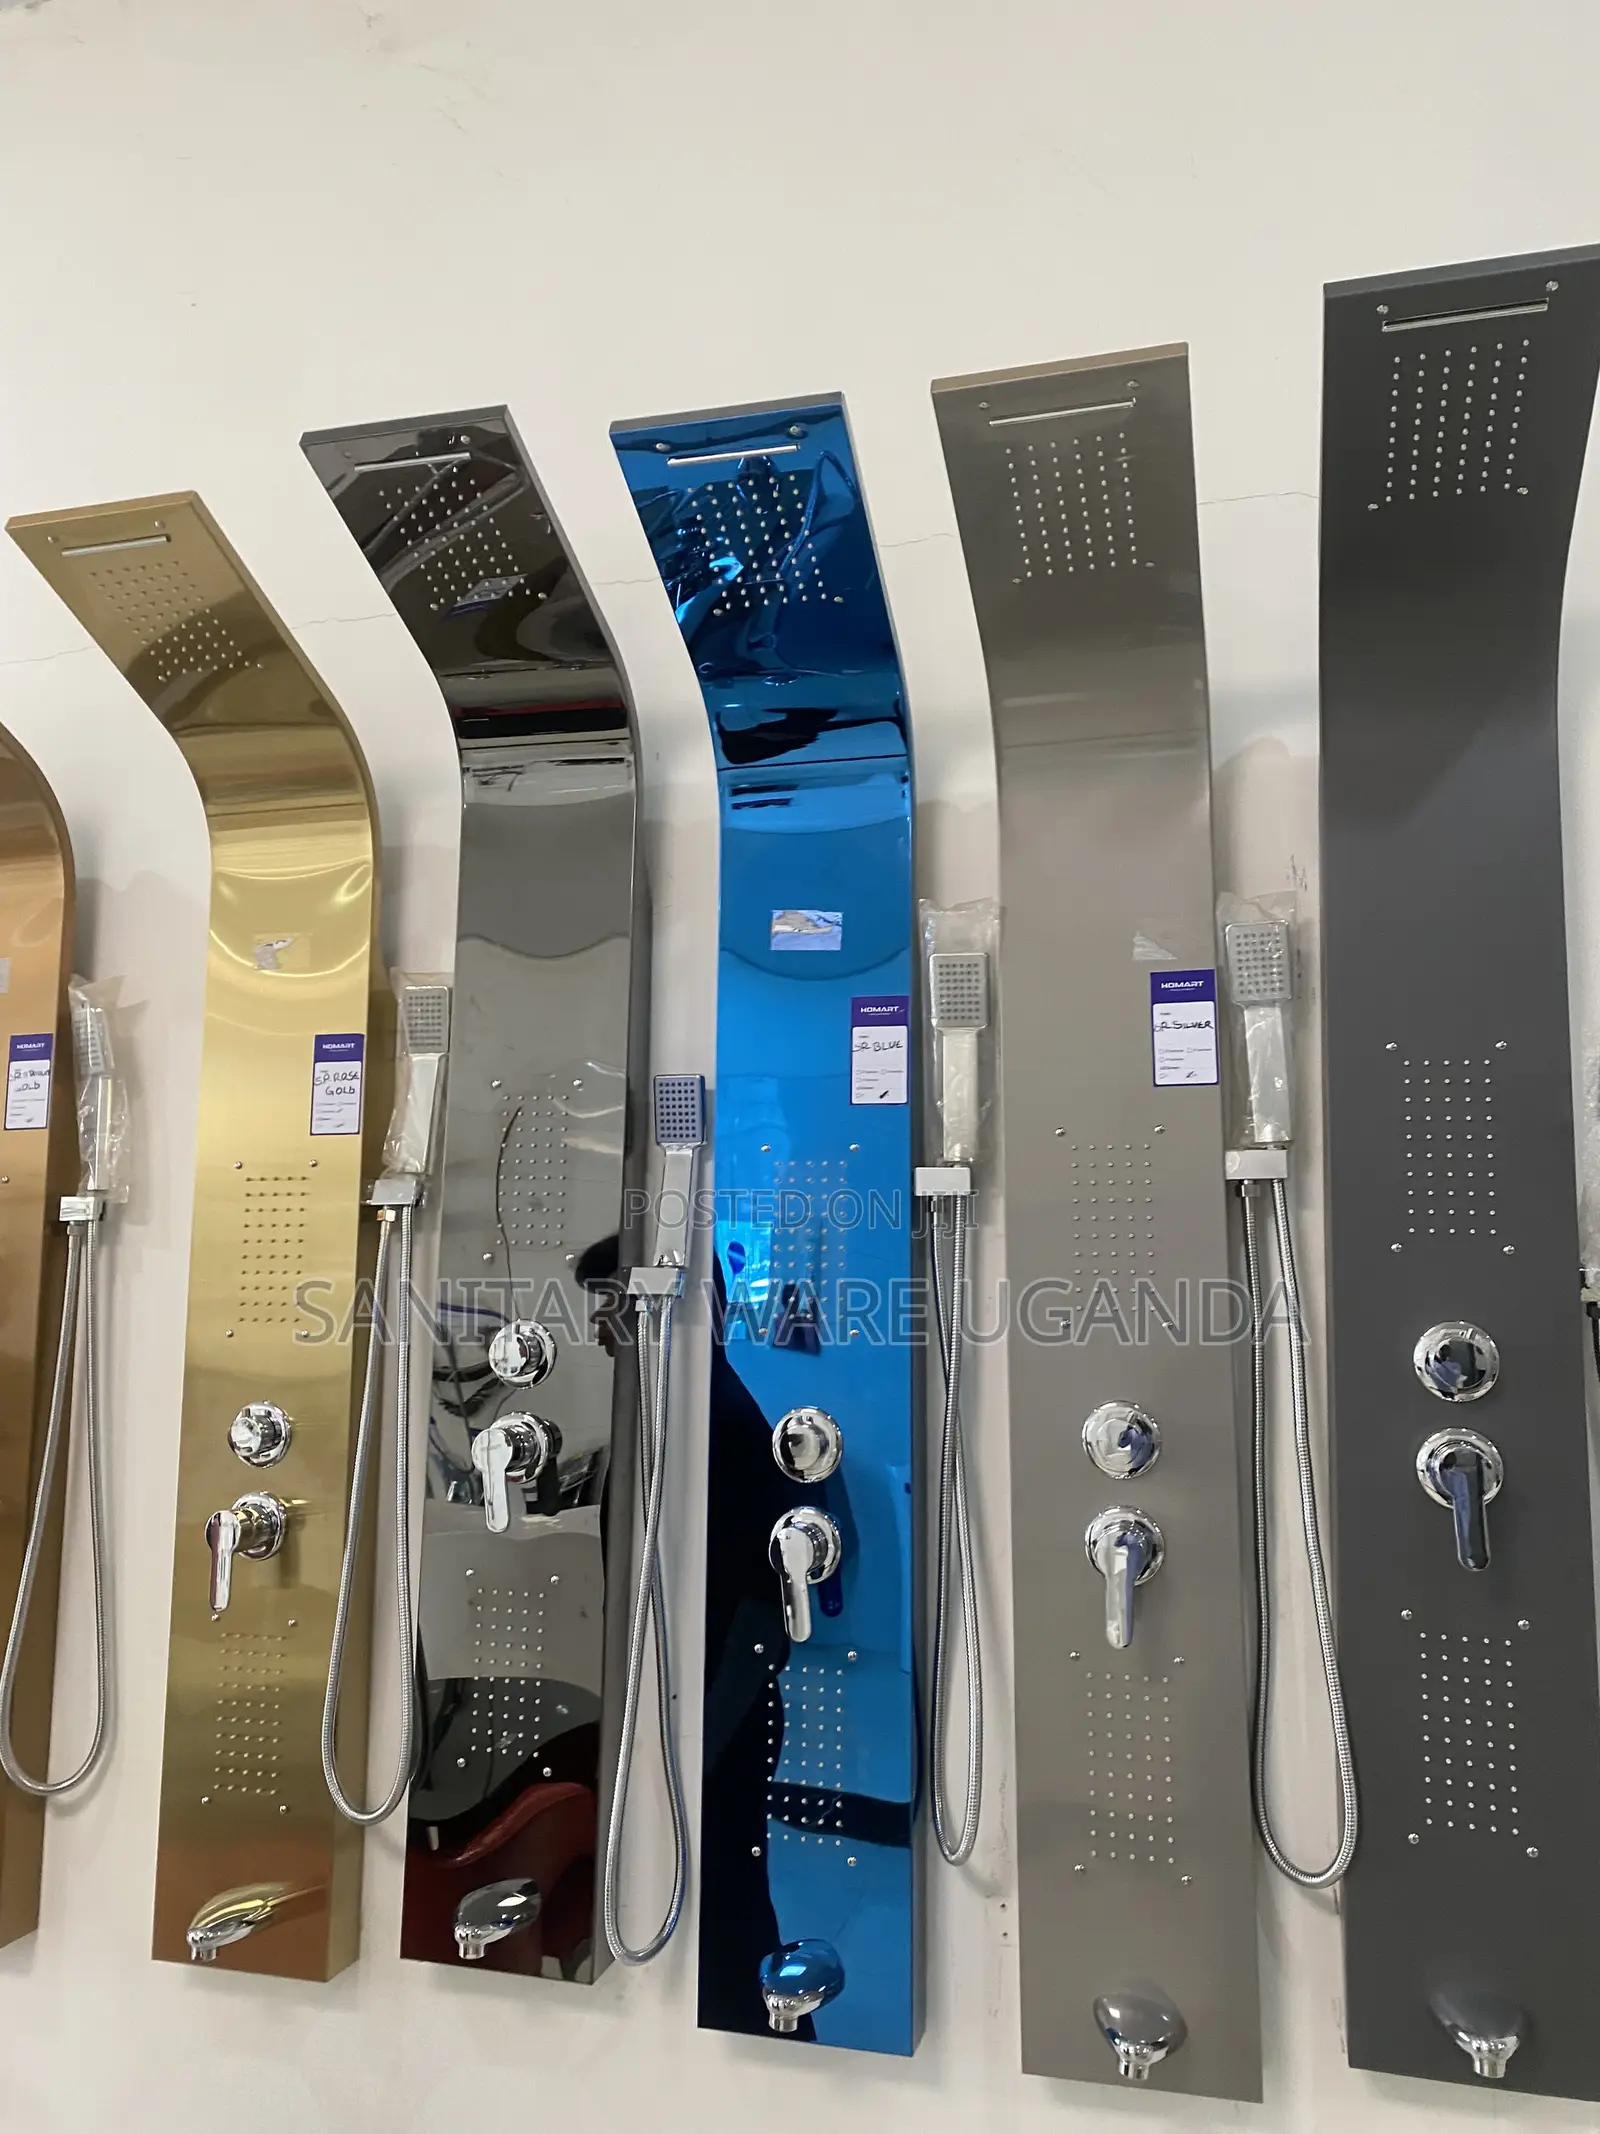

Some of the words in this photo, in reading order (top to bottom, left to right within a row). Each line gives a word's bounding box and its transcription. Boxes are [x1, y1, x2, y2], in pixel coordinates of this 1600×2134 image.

[1161, 980, 1204, 989] HOMART
[860, 1005, 900, 1013] HOMART
[1172, 1020, 1214, 1030] SILVER
[16, 1042, 45, 1050] HOMART
[322, 1042, 356, 1050] HOMART
[873, 1040, 904, 1052] BLUE
